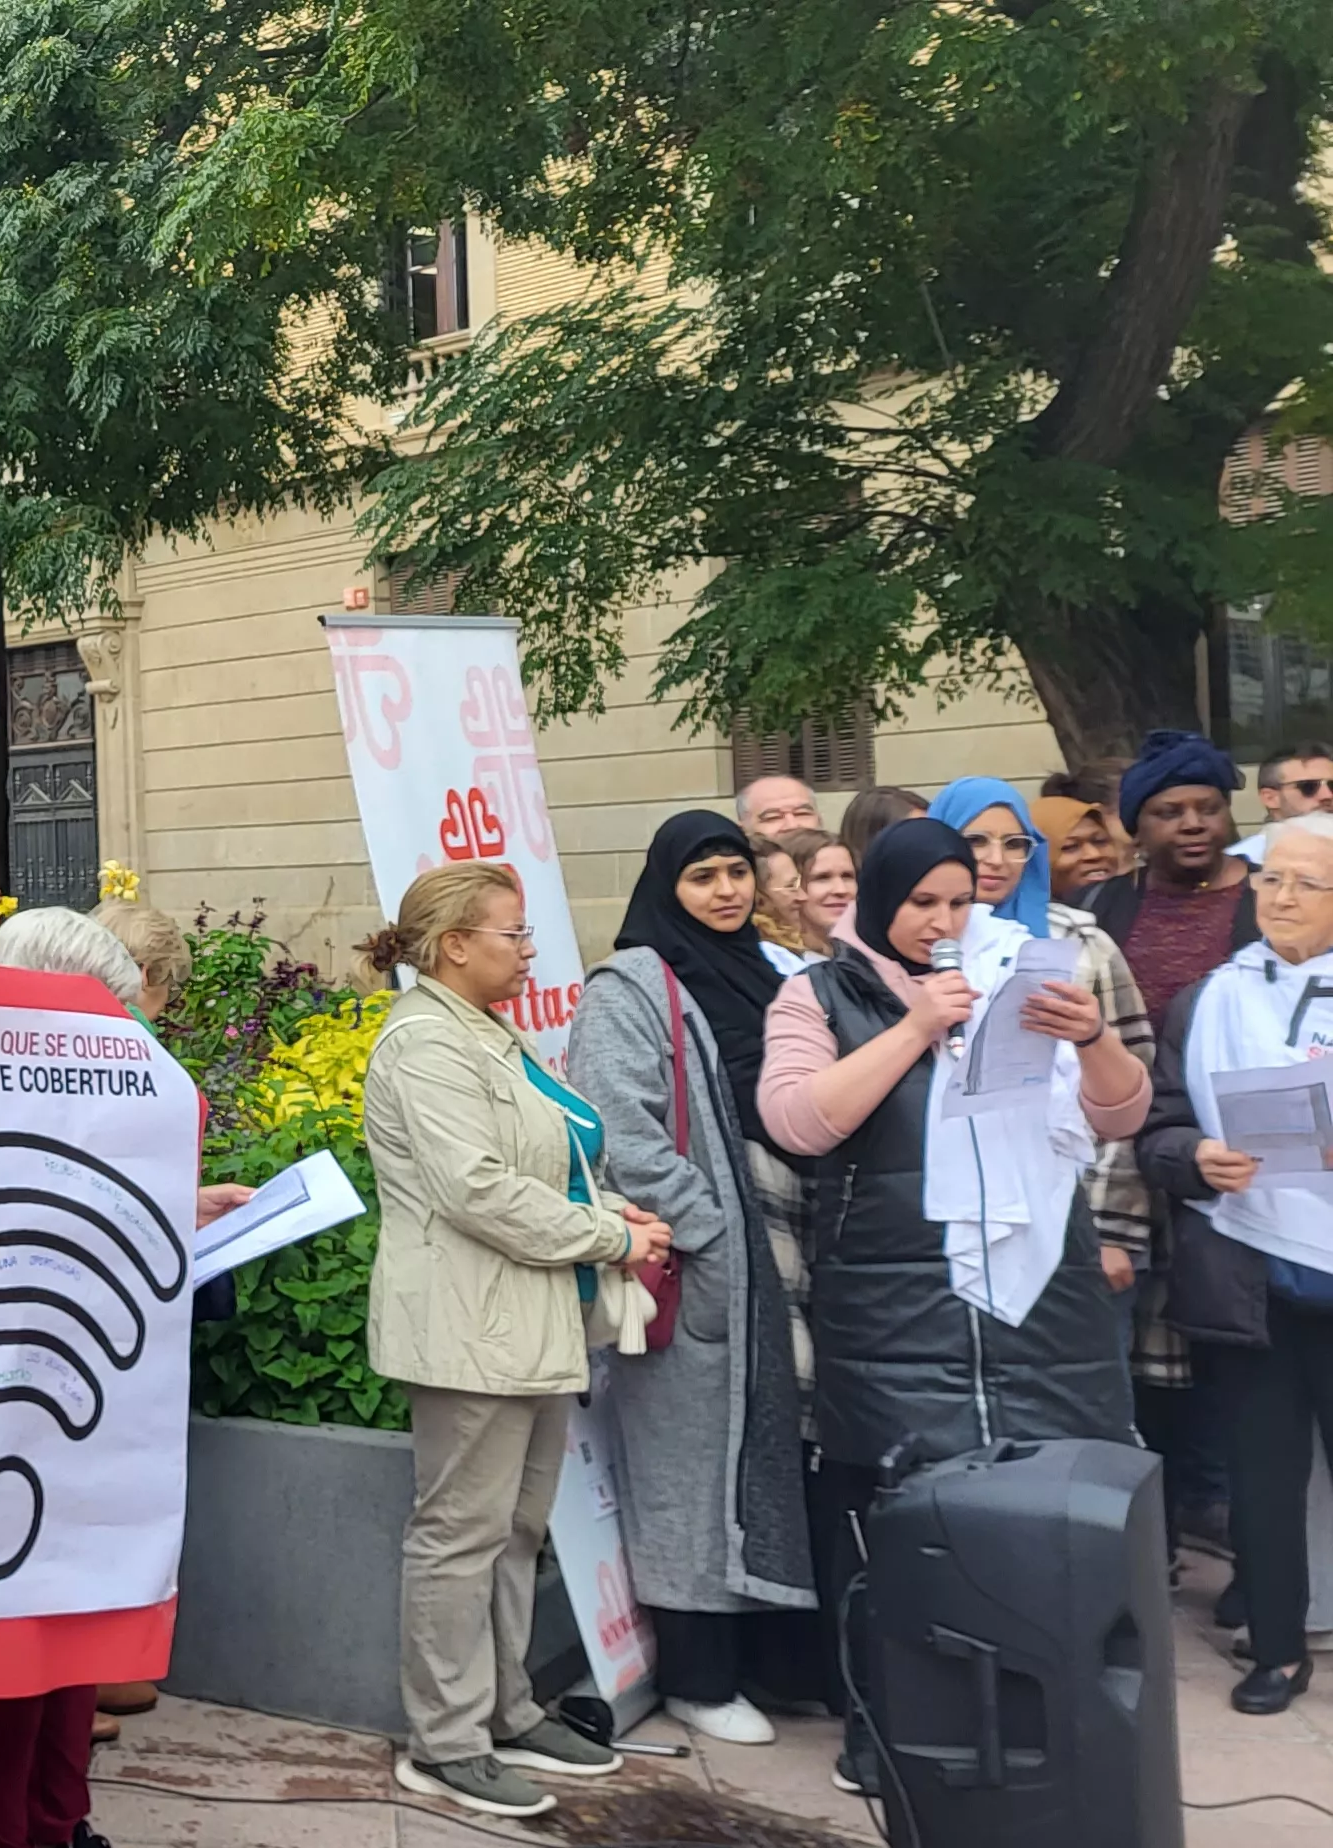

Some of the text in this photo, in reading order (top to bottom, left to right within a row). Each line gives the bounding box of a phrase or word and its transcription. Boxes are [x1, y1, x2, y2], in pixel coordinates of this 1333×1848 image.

[1, 1030, 40, 1057] QUE
[45, 1033, 68, 1058] SE
[73, 1034, 152, 1062] QUEDEN
[19, 1065, 159, 1098] COBERTURA
